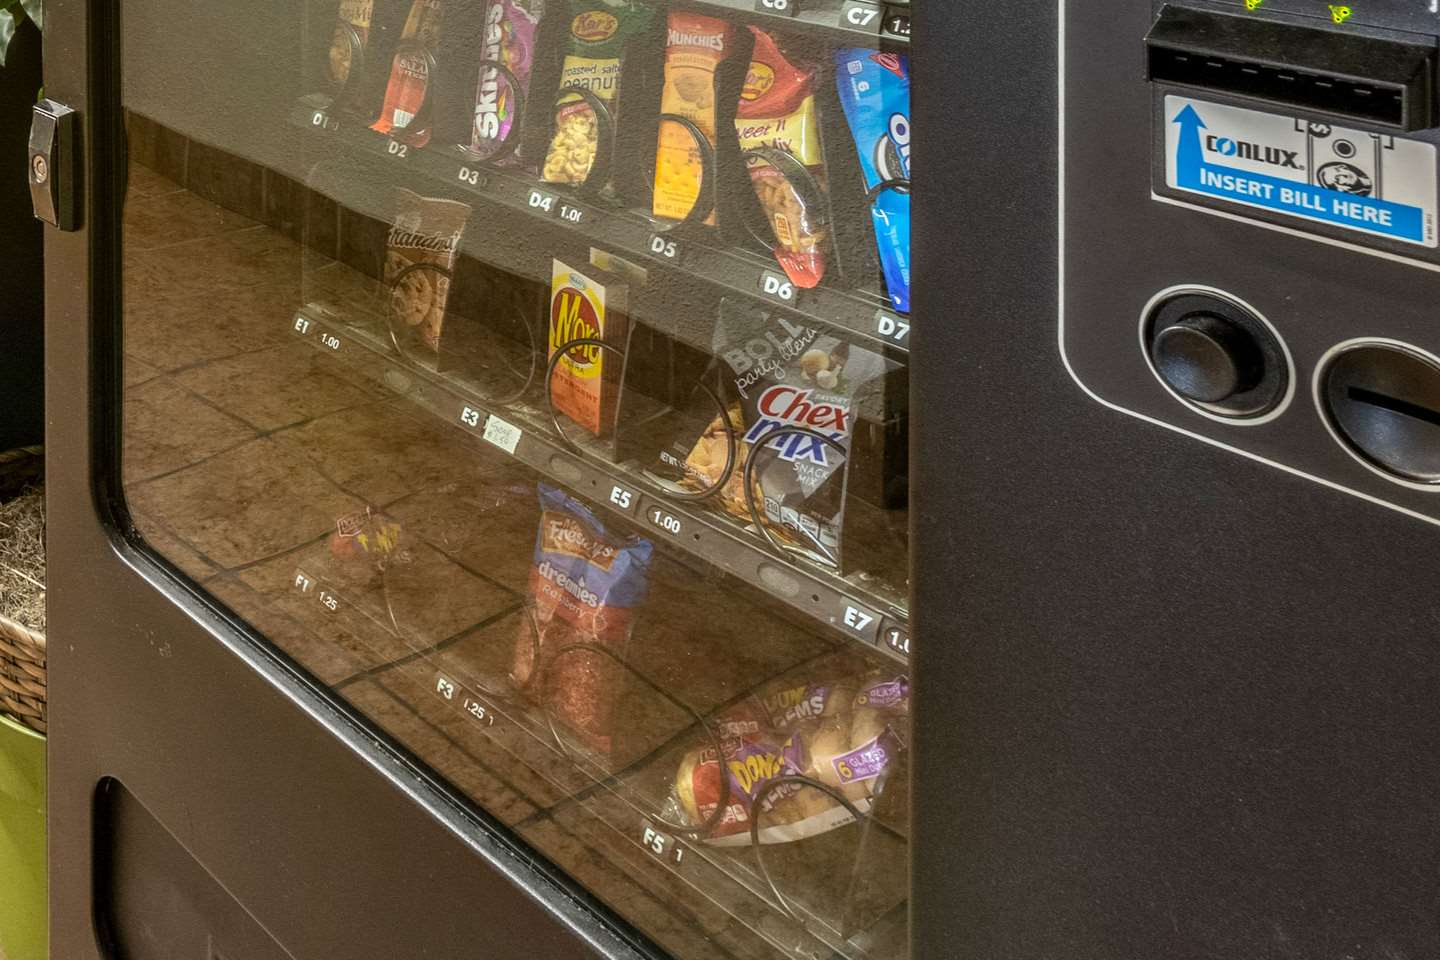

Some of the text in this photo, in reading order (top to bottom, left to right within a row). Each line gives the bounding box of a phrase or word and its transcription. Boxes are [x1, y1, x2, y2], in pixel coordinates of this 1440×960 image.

[576, 13, 616, 31] Kar's
[846, 7, 879, 26] C7
[667, 27, 724, 52] MUNCHIES
[565, 65, 597, 76] roasted
[312, 112, 329, 128] D1
[388, 141, 408, 157] D2
[458, 166, 479, 185] D3
[528, 191, 553, 212] D4
[1200, 167, 1274, 201] INSERT
[1279, 187, 1326, 212] BILL
[1332, 197, 1393, 227] HERE
[651, 236, 677, 258] D5
[763, 275, 793, 300] D6
[294, 317, 340, 350] E1 1.00
[878, 316, 910, 340] D7
[734, 356, 786, 400] party
[460, 407, 480, 427] E3
[759, 385, 850, 433] Chex
[792, 461, 828, 481] SNACK
[795, 474, 819, 487] MIX
[610, 486, 681, 534] E5 1.00
[295, 574, 338, 610] F1 1.25
[843, 605, 873, 631] E7
[436, 678, 454, 700] F3
[463, 697, 486, 720] 1.25
[837, 761, 852, 779] 6
[643, 827, 665, 854] F5
